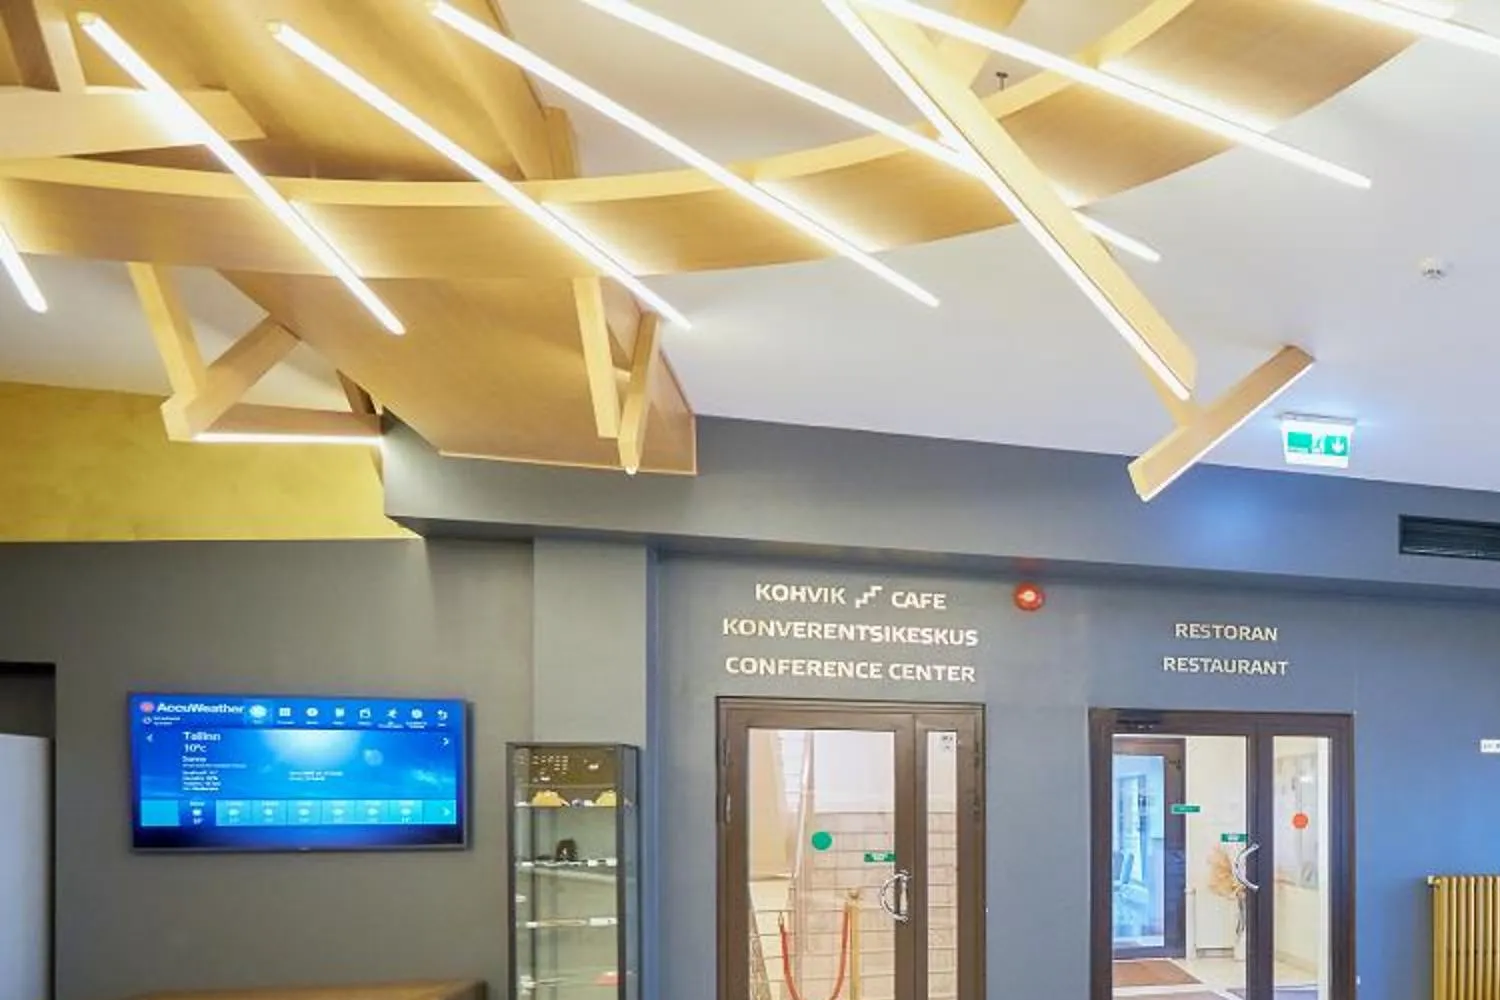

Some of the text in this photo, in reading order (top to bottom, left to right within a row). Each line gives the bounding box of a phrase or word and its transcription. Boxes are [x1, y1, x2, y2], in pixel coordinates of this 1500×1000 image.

[755, 583, 947, 610] KOHVIK CAFE
[723, 617, 979, 647] KONVERENTSIKESKUS
[1175, 623, 1278, 641] RESTORAN
[725, 656, 976, 683] CONFERENCE CENTER
[1163, 656, 1289, 676] RESTAURANT
[156, 702, 244, 714] AccuWeather
[182, 731, 221, 741] Tallinn
